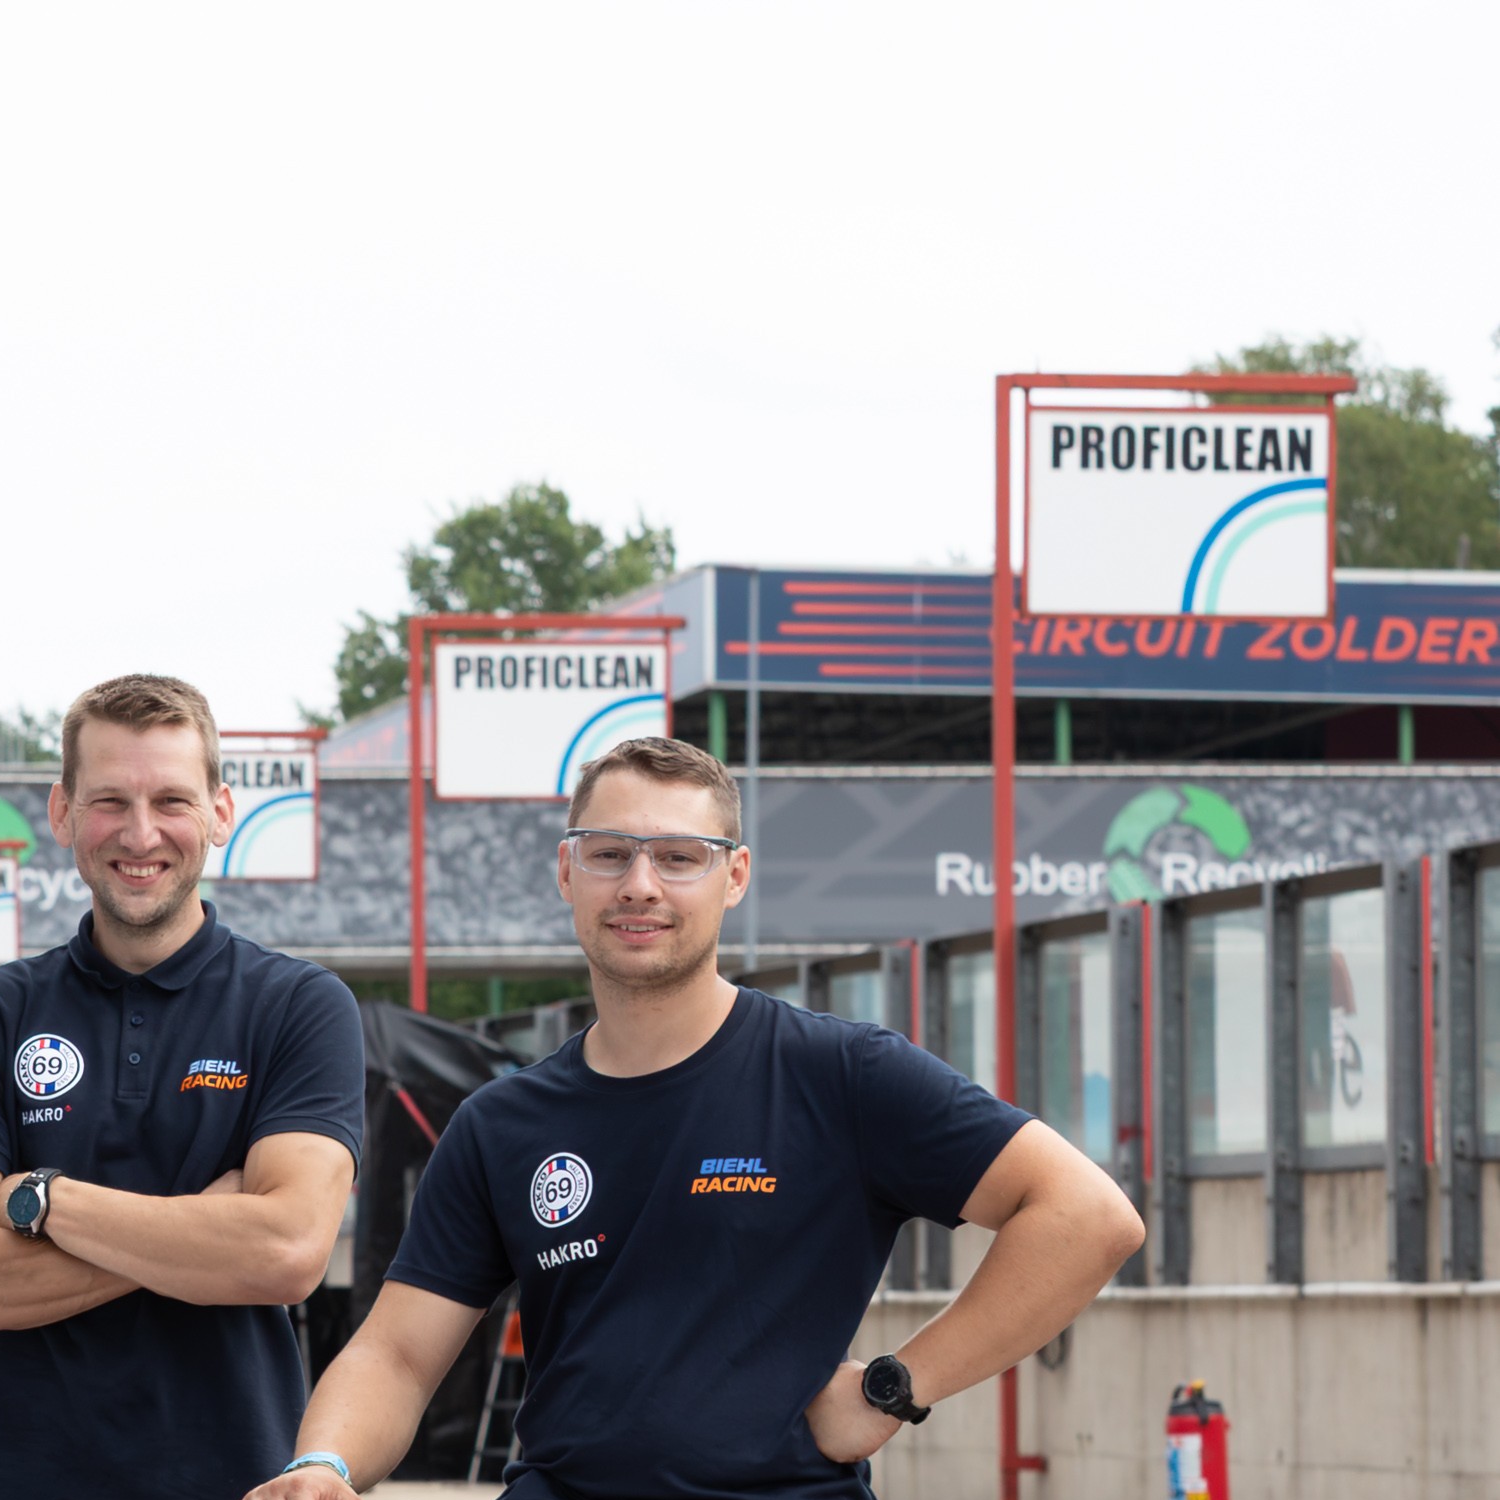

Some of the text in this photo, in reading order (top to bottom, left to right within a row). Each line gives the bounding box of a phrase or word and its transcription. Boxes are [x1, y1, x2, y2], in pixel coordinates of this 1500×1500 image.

[1051, 424, 1314, 474] PROFICLEAN
[1247, 616, 1498, 665] ZOLDER
[453, 653, 655, 691] PROFICLEAN
[935, 852, 1107, 896] Ruber
[32, 1055, 63, 1076] 69
[188, 1059, 241, 1075] BIEHL
[179, 1074, 248, 1092] RACING
[22, 1107, 63, 1126] HAKRO
[699, 1157, 767, 1175] BIEHL
[545, 1177, 572, 1204] 69
[690, 1176, 777, 1194] RACING
[536, 1238, 598, 1271] HAKRO
